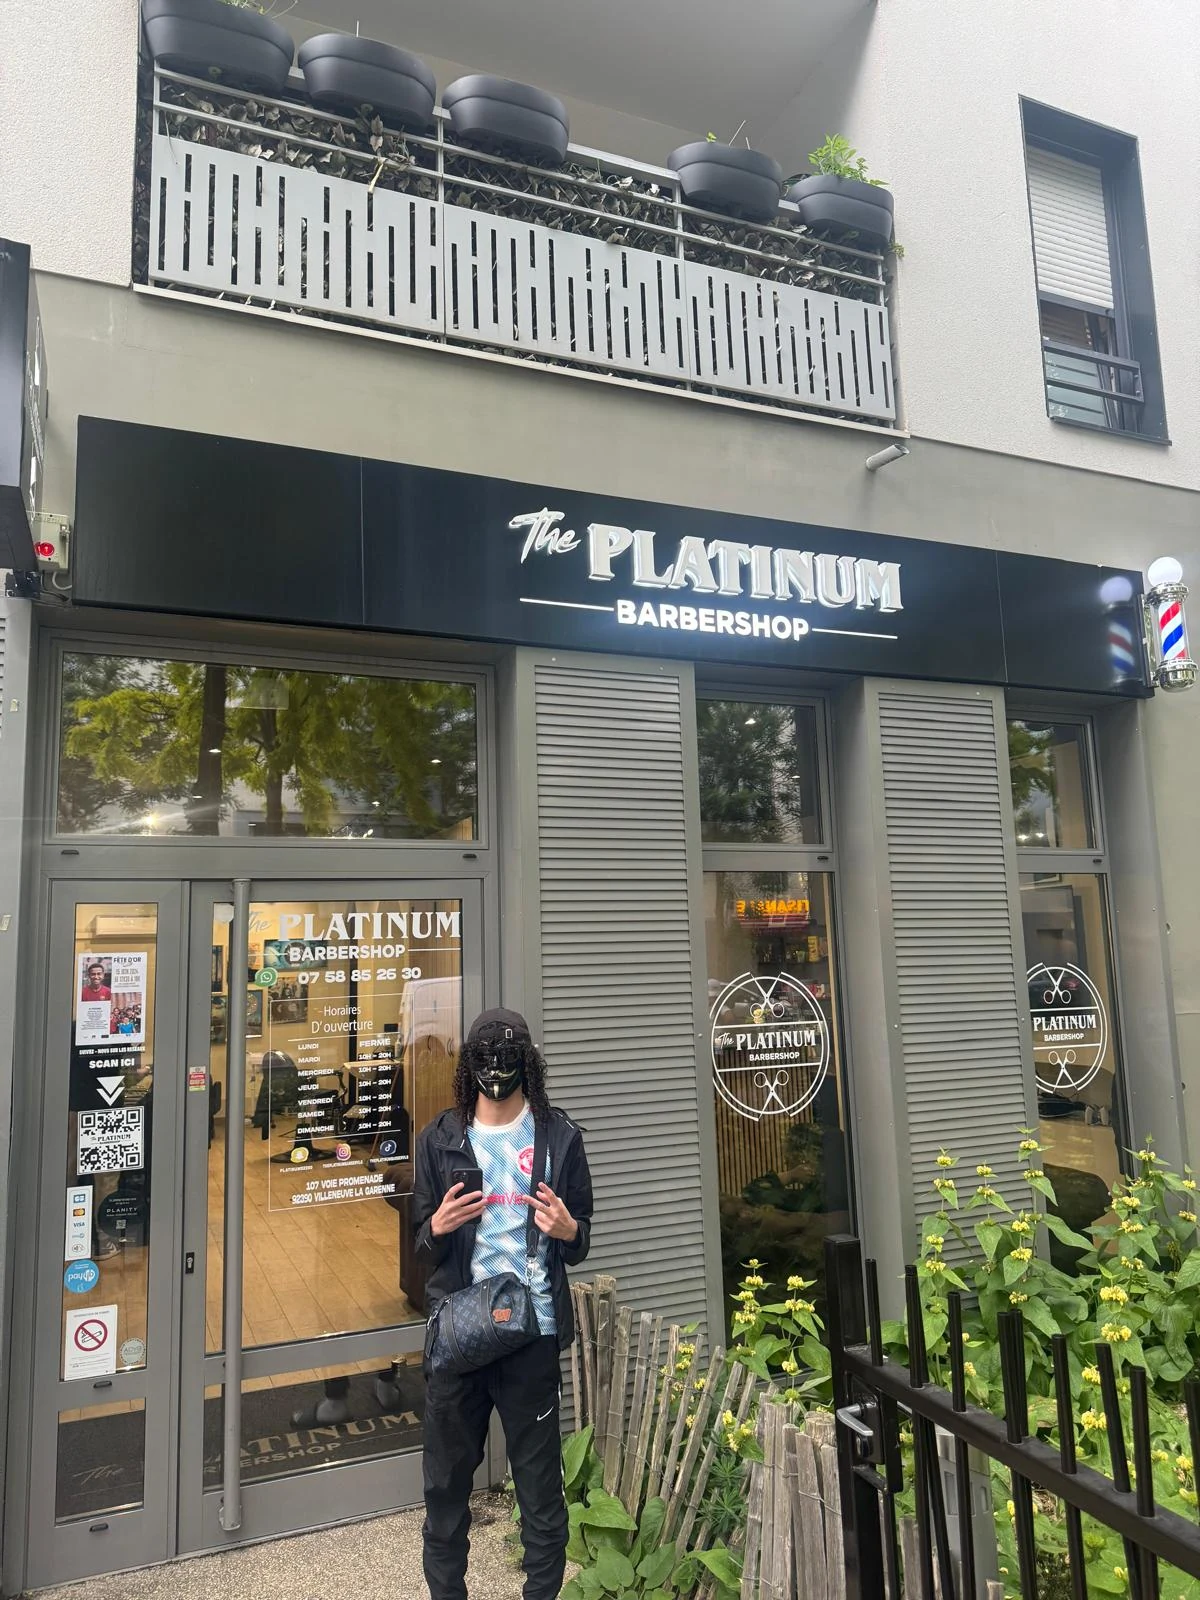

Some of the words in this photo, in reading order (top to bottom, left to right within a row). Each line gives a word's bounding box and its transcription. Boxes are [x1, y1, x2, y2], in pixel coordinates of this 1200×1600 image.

[508, 507, 581, 564] The
[588, 522, 904, 613] PLATINUM
[617, 599, 809, 641] BARBERSHOP
[278, 912, 461, 942] PLATINUM
[289, 945, 406, 961] BARBERSHOP
[298, 972, 320, 985] 07
[325, 970, 346, 984] 58
[351, 969, 371, 982] 85
[376, 968, 397, 981] 26
[401, 967, 421, 979] 30
[324, 1004, 361, 1017] Horaires
[1032, 1014, 1097, 1031] PLATINUM
[714, 1032, 735, 1050] The
[735, 1030, 817, 1051] PLATINUM
[1044, 1033, 1085, 1041] BARBERSHOP
[89, 1059, 119, 1069] SCAN
[121, 1058, 135, 1067] ICI
[749, 1051, 800, 1061] BARBERSHOP
[297, 1068, 334, 1077] MERCREDI
[297, 1097, 333, 1106] VENDREDI
[297, 1125, 334, 1134] DIMANCHE
[306, 1181, 319, 1190] 107
[321, 1179, 337, 1189] VOIE
[338, 1174, 384, 1187] PROMENADE
[314, 1188, 353, 1202] VILLENEUVE
[354, 1188, 364, 1196] LA
[364, 1184, 395, 1195] GARENNE
